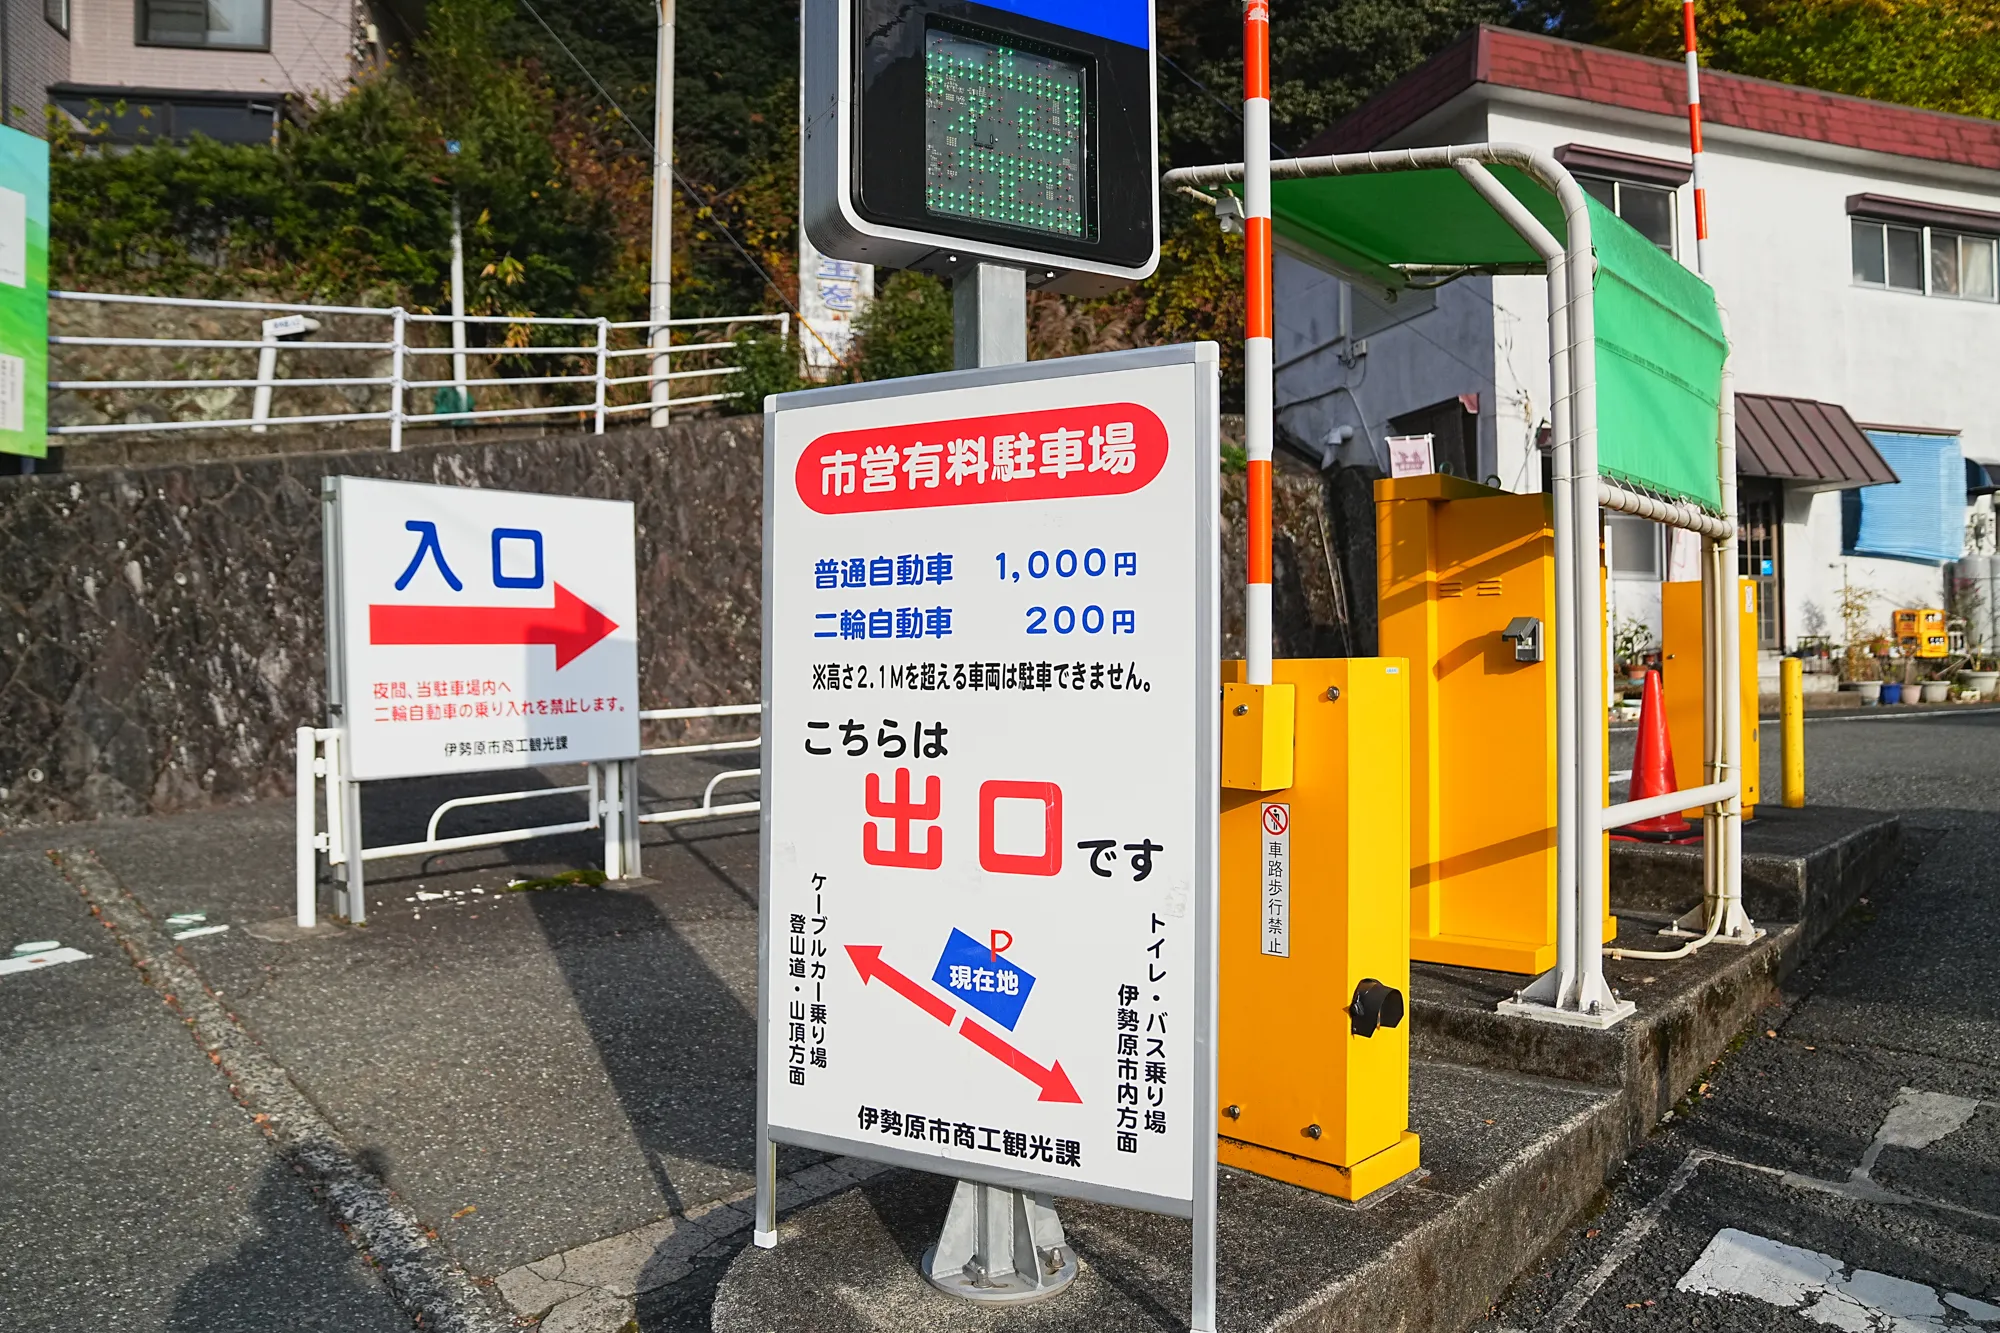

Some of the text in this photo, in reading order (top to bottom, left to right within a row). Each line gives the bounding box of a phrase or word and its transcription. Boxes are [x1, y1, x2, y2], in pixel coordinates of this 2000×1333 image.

[820, 421, 1137, 497] 市営有料駐車場
[394, 519, 545, 592] 入口
[814, 547, 1138, 590] 普通自動車 1,000円
[813, 604, 1136, 641] 二輪自動車 200円
[373, 679, 512, 701] 夜間、当駐車場内へ
[374, 696, 626, 723] 二輪自動車の乗り入れを禁止します。
[444, 735, 569, 757] 伊勢原市商工観光課
[804, 718, 949, 759] こちらは
[863, 767, 1164, 882] 出口 です
[1267, 840, 1284, 954] 車路歩行禁止
[809, 872, 829, 1069] ケーブルカー乗り場
[990, 929, 1013, 962] P
[788, 913, 807, 1086] 登山道・山頂方面
[948, 965, 1020, 997] 現在地
[1143, 912, 1169, 1135] トイレ・バス乗り場
[1116, 983, 1140, 1154] 伊勢原市内方面
[857, 1105, 1082, 1168] 伊勢原市商工観光課
